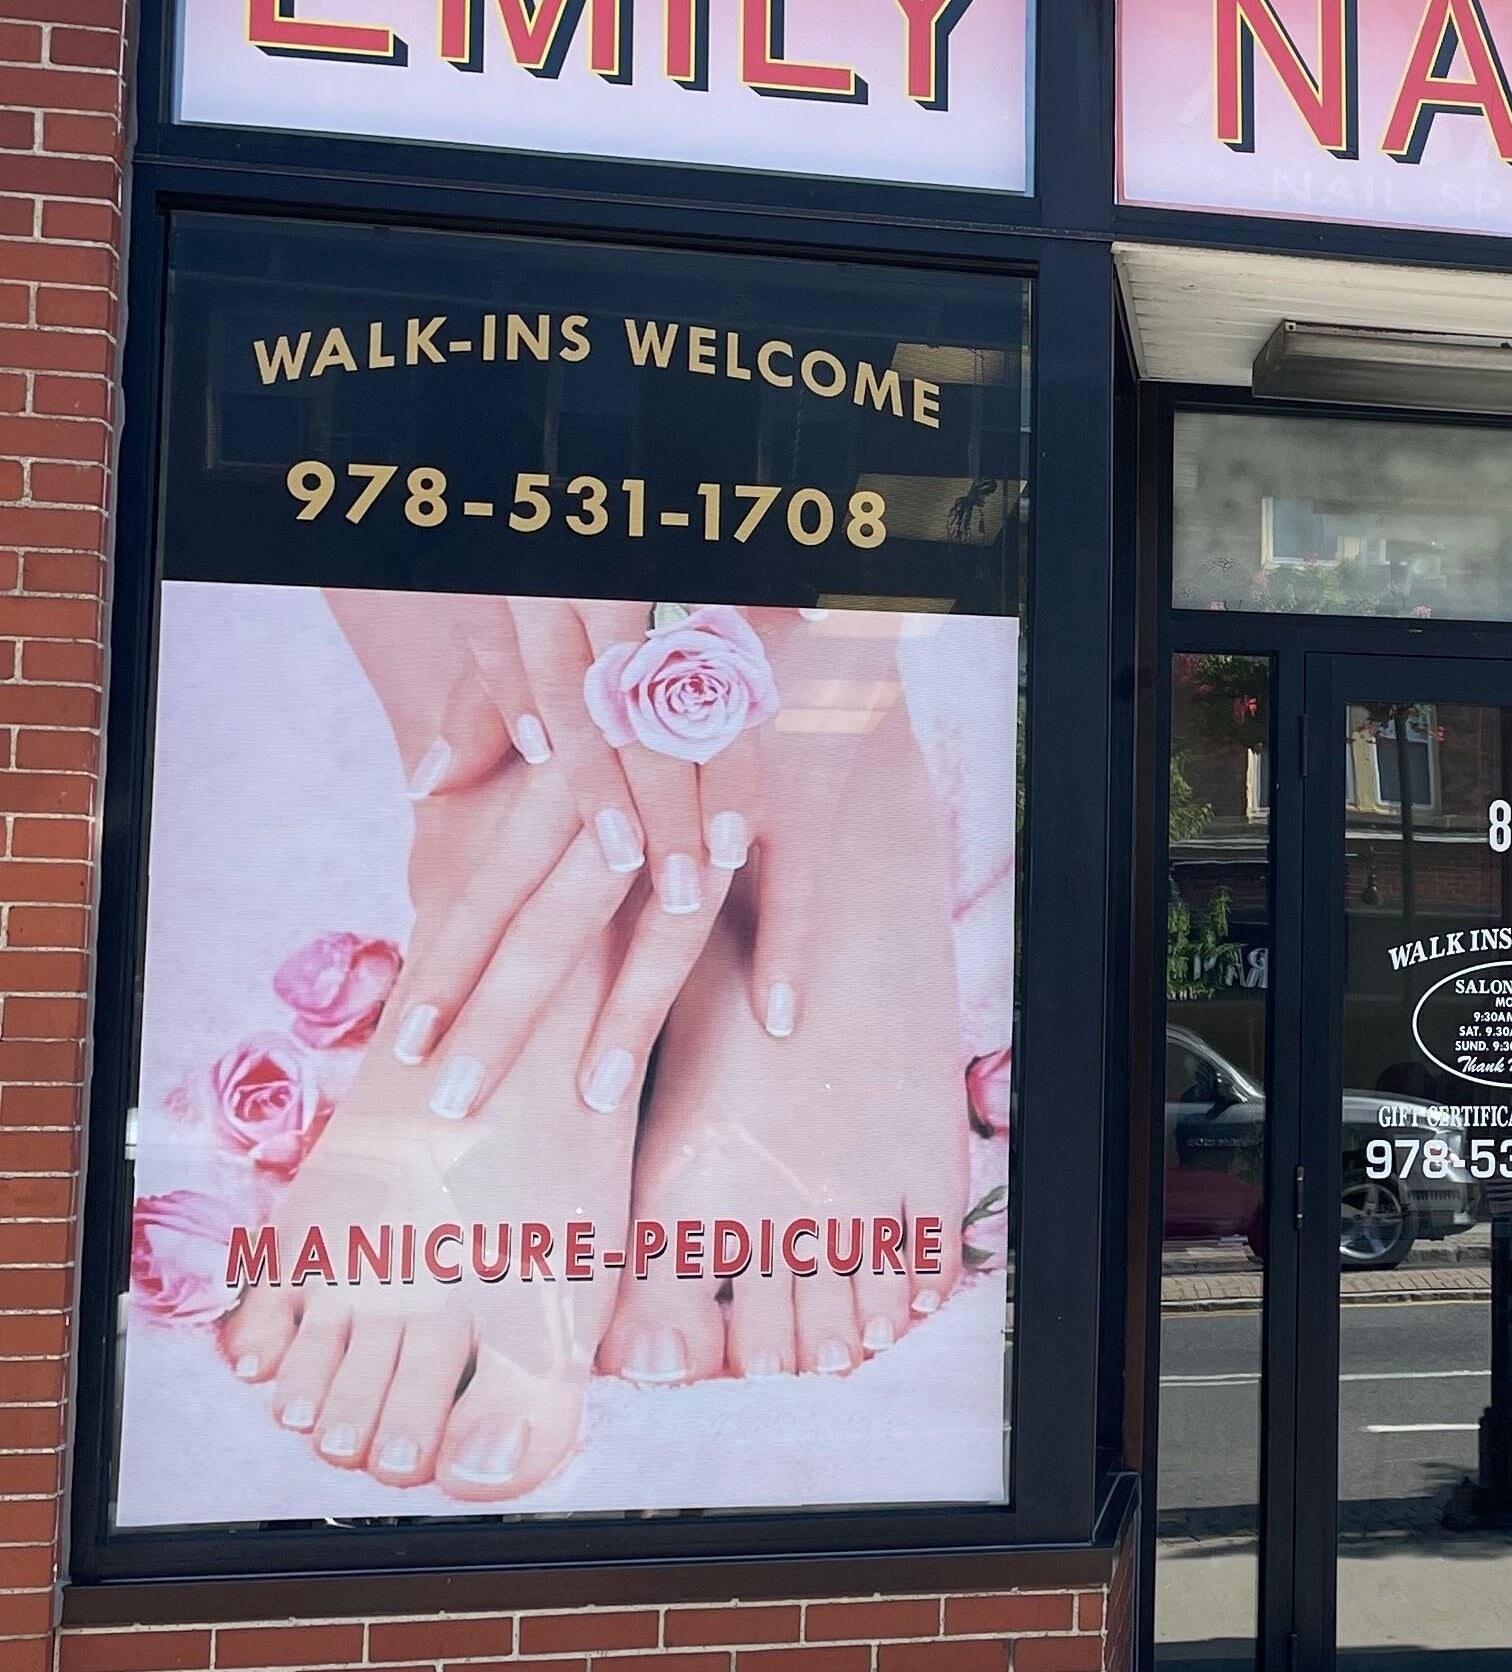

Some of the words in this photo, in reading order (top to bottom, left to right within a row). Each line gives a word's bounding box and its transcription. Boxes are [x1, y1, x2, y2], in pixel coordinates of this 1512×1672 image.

[245, 0, 974, 112] MILY
[252, 314, 591, 386] WALK-INS
[625, 318, 942, 430] WELCOME
[286, 459, 887, 550] 978-531-1708
[1388, 931, 1466, 971] WALK
[1469, 928, 1512, 952] INS
[1454, 1041, 1489, 1051] SUND.
[1459, 1026, 1482, 1037] SAT.
[1457, 1055, 1506, 1073] Thank
[1378, 1106, 1419, 1128] GIFT
[225, 1216, 946, 1288] MANICURE-PEDICURE
